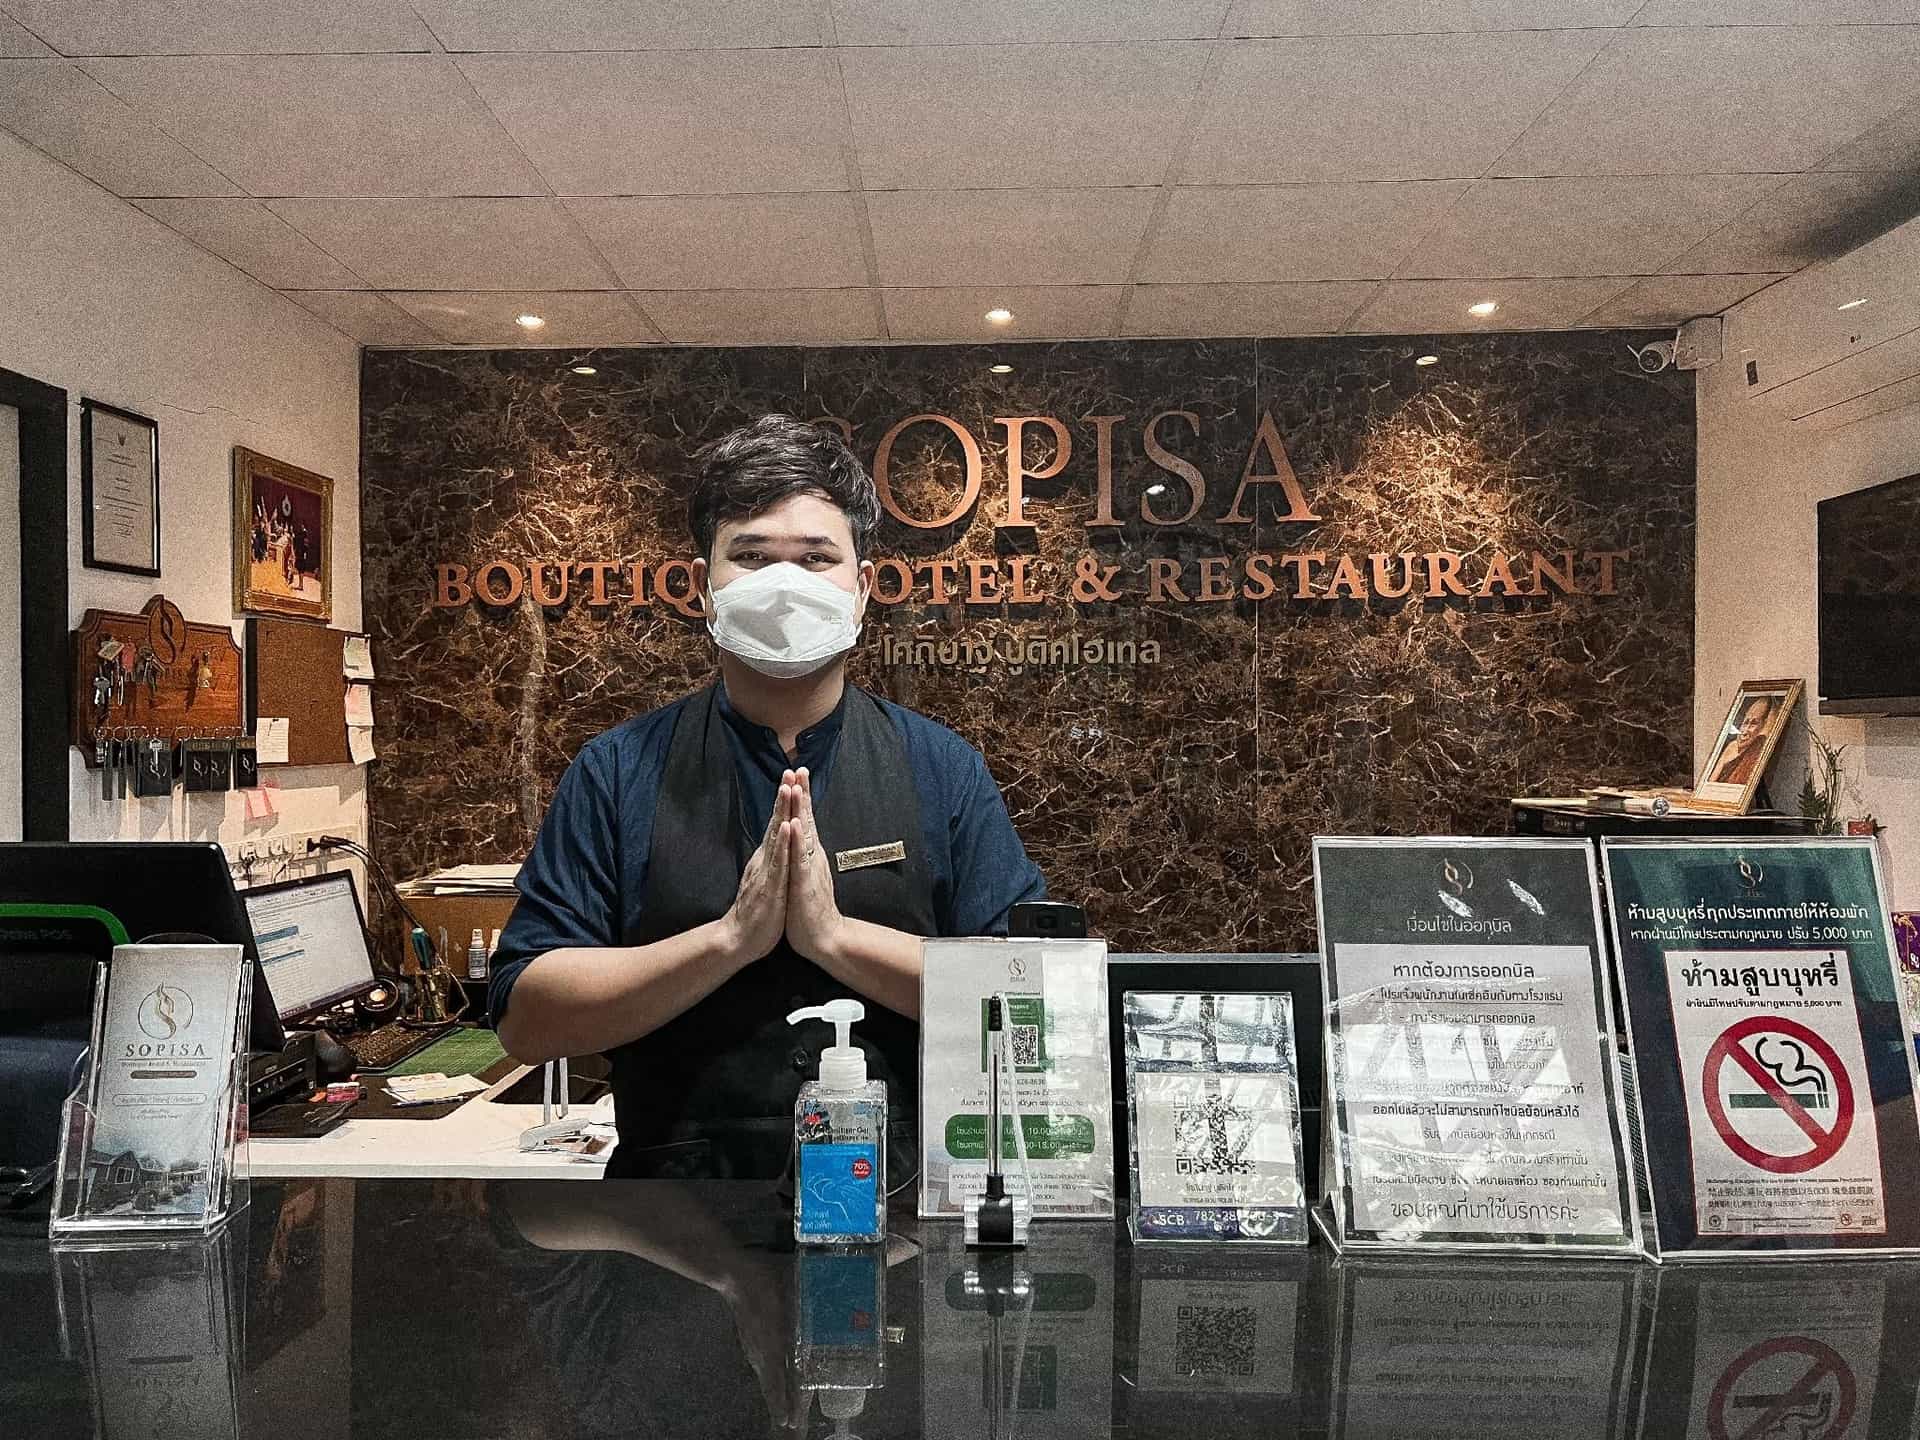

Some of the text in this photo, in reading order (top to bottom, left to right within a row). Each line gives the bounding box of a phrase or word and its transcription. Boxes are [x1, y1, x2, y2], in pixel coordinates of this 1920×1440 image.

[431, 547, 1632, 618] BOUTIQ OTEL & RESTAURANT
[1812, 926, 1848, 941] 5,000
[1393, 960, 1535, 978] หากต้องการออกบิล
[1681, 952, 1839, 997] ห้ามสูบบุหรี่
[125, 1043, 206, 1058] SOPISA
[1158, 1215, 1185, 1226] SCB
